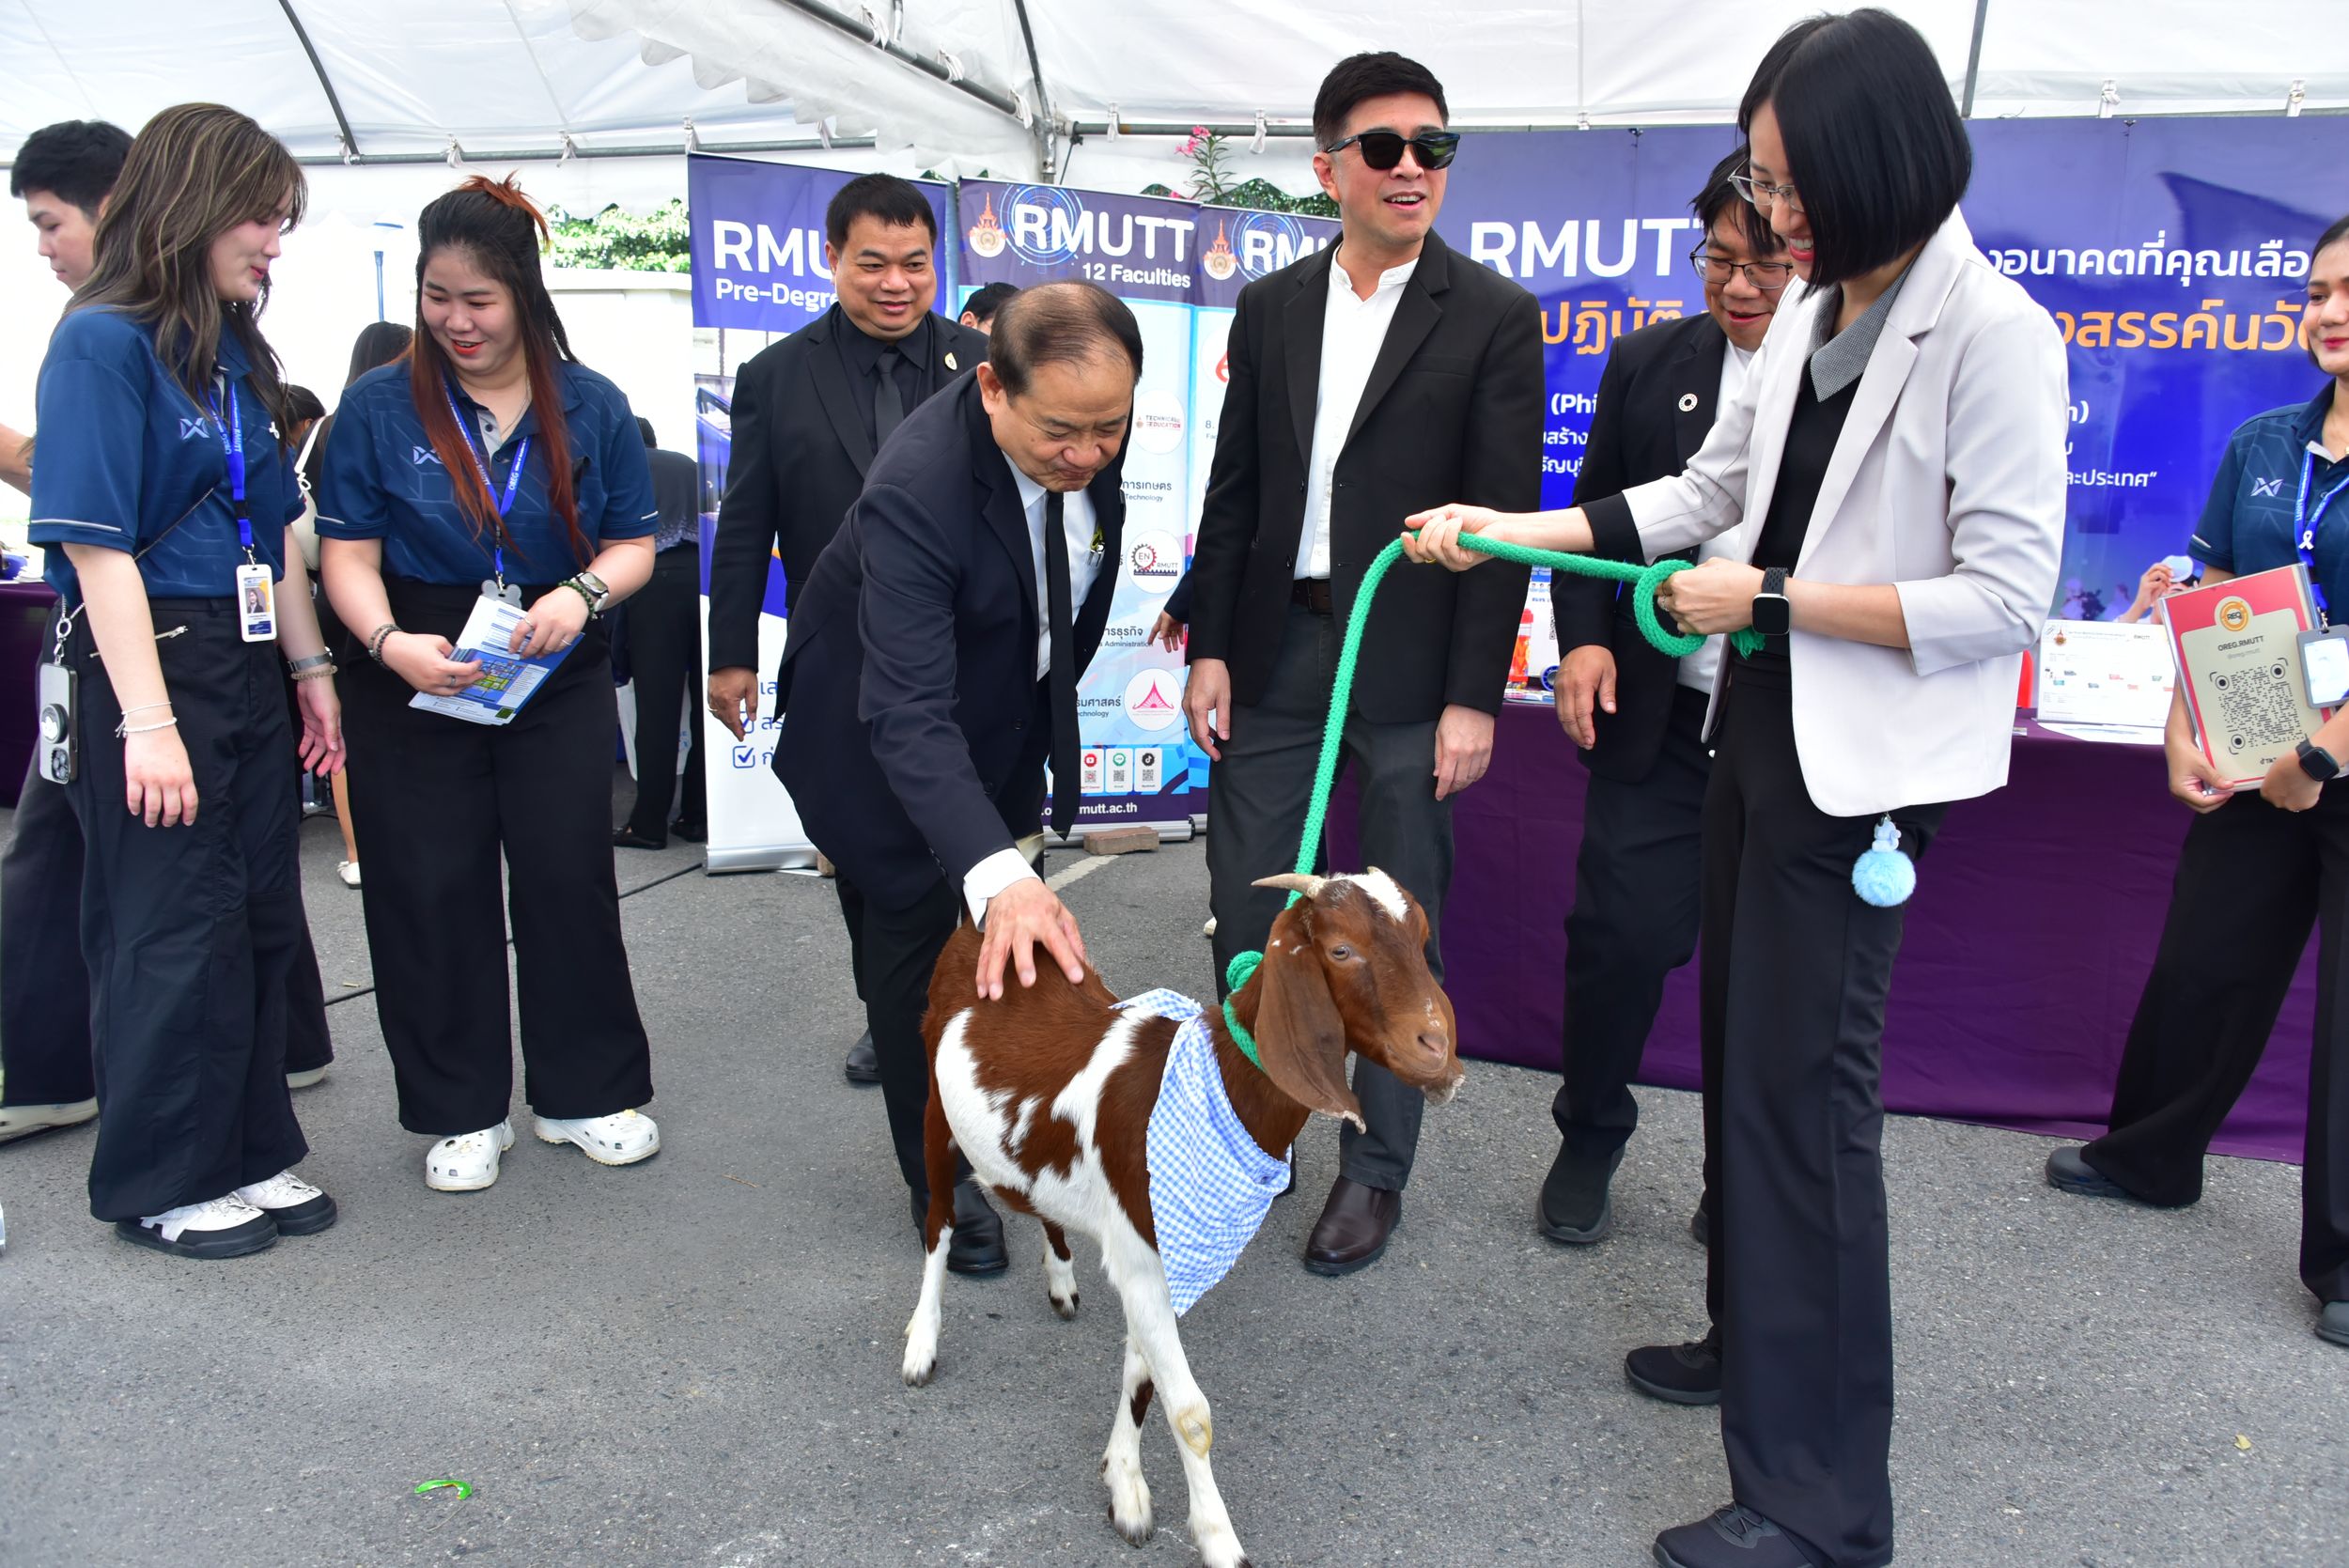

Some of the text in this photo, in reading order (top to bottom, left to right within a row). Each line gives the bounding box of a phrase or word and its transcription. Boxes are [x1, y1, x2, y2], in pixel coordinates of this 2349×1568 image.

[1014, 203, 1195, 262] RMUTT
[1470, 219, 1706, 277] RMUT
[1082, 262, 1190, 288] 12 Faculties
